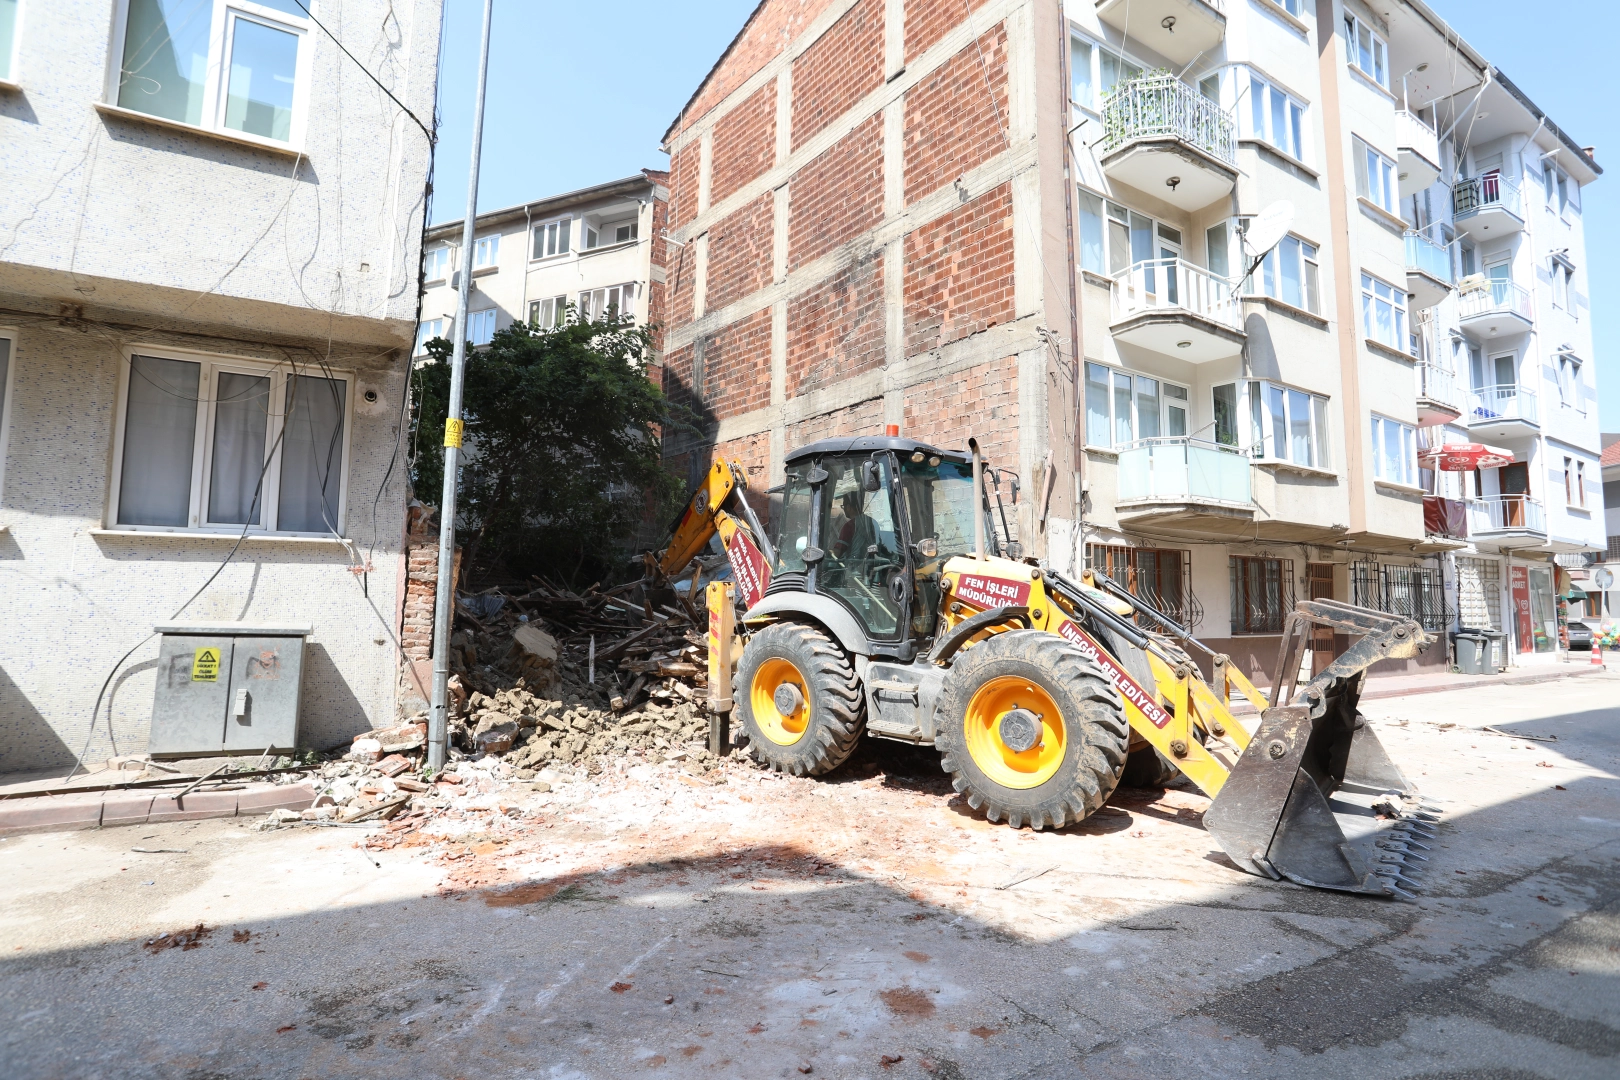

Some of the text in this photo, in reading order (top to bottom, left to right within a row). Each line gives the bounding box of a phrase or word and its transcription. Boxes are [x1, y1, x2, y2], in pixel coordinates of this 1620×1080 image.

[727, 548, 751, 601] MÜDÜRLÜĞÜ
[734, 547, 754, 593] FEN İŞLERİ
[965, 576, 1019, 599] FEN İŞLERİ
[1511, 580, 1526, 589] ARKET
[1100, 661, 1167, 726] BELEDİYESİ
